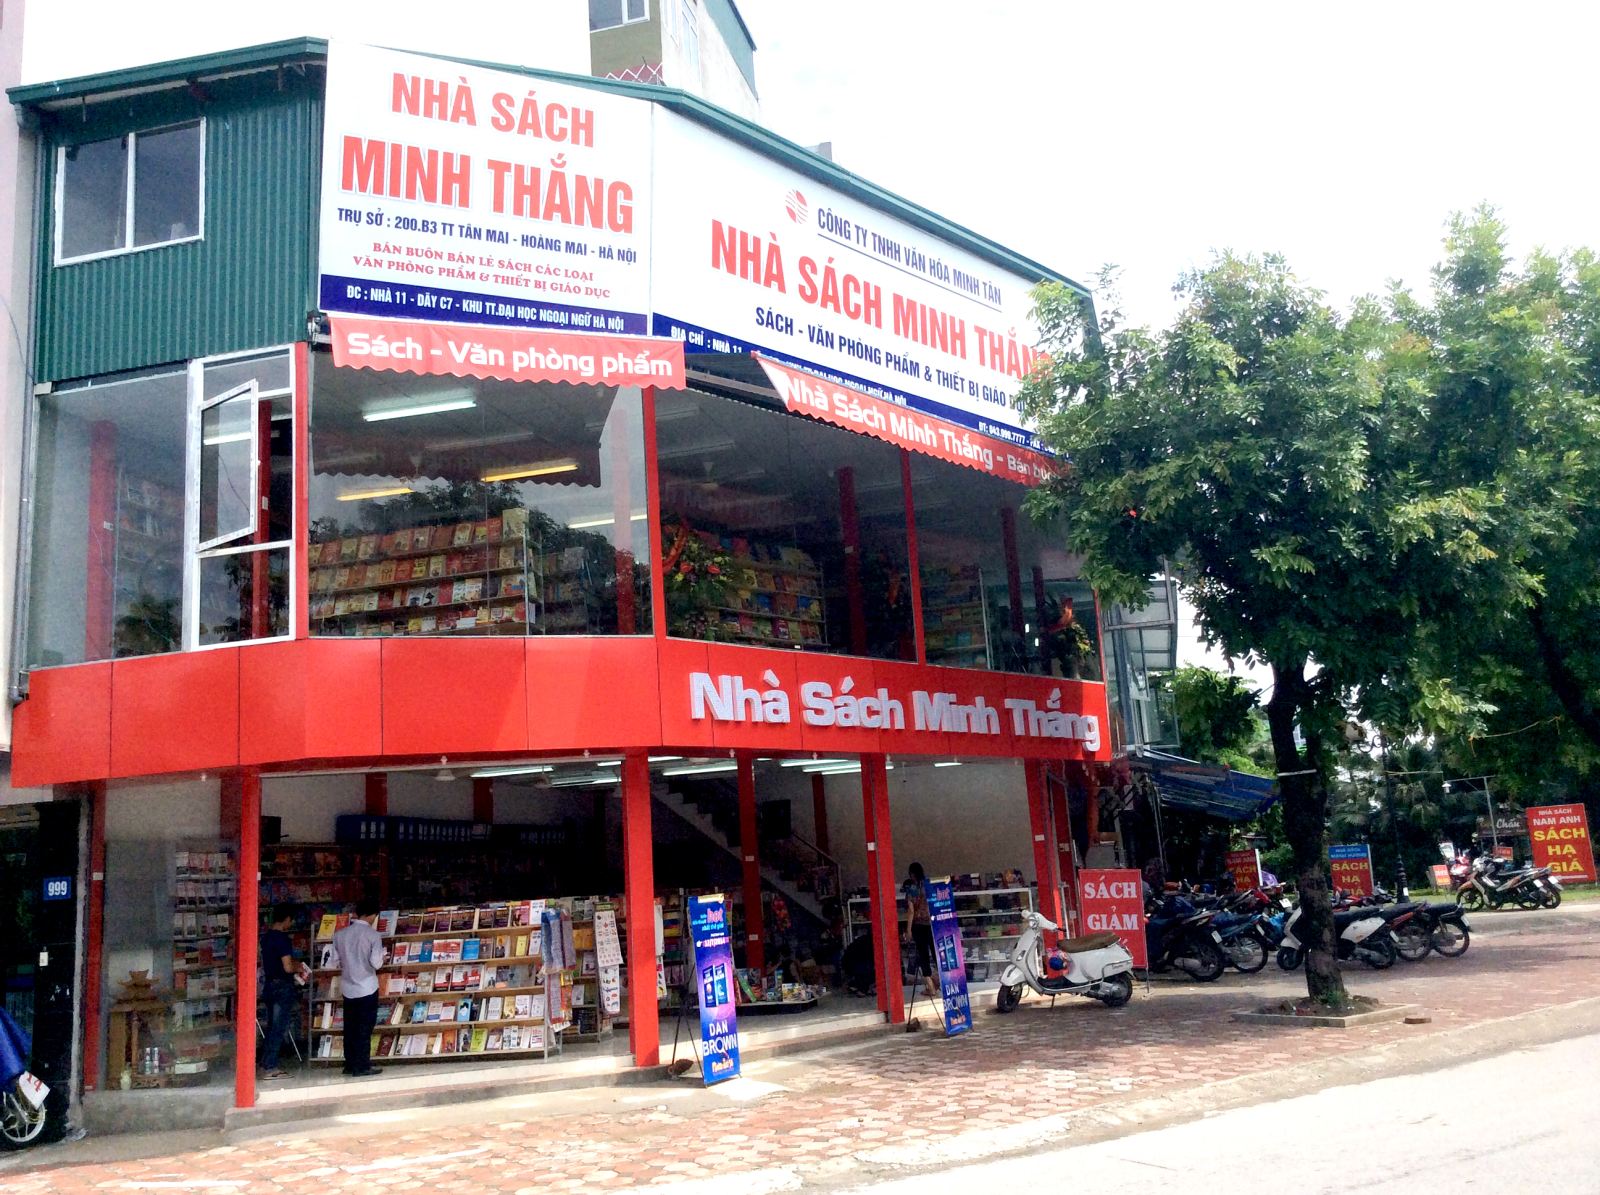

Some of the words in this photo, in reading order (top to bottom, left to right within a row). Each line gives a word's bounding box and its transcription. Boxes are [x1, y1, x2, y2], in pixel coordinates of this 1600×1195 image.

[392, 72, 477, 127] NHÀ
[491, 89, 594, 148] SÁCH
[341, 134, 471, 209] MINH
[486, 152, 634, 234] THẮNG
[337, 208, 361, 226] TRỤ
[366, 207, 384, 226] SỞ
[395, 215, 437, 234] 200.B3
[441, 222, 454, 236] TT
[458, 222, 482, 241] TÂN
[486, 228, 509, 244] MAI
[521, 233, 561, 252] HOÀNG
[565, 240, 587, 256] MAI
[599, 244, 613, 260] HÀ
[617, 247, 637, 266] NỘI
[373, 241, 402, 254] BÁN
[405, 246, 443, 261] BUÔN
[447, 251, 475, 265] BÁN
[479, 254, 494, 268] LẺ
[497, 258, 532, 272] SÁCH
[535, 264, 561, 277] CÁC
[564, 269, 594, 283] LOẠI
[817, 207, 851, 240] CÔNG
[854, 224, 868, 248] TY
[871, 232, 901, 262] TNHH
[904, 246, 927, 273] VĂN
[929, 258, 950, 284] HÓA
[953, 268, 980, 297] MINH
[982, 280, 1002, 306] TÂN
[353, 255, 383, 268] VĂN
[387, 260, 434, 275] PHÒNG
[438, 265, 476, 281] PHẨM
[479, 272, 490, 282] &
[493, 273, 531, 288] THIẾT
[534, 279, 547, 292] BỊ
[550, 281, 582, 295] GIÁO
[585, 286, 611, 299] DỤC
[346, 285, 361, 299] ĐC
[370, 286, 392, 304] NHÀ
[395, 291, 407, 305] 11
[440, 296, 453, 310] C7
[462, 299, 483, 314] KHU
[485, 301, 515, 320] TT.ĐẠI
[517, 305, 537, 323] HỌC
[539, 308, 569, 327] NGOẠI
[571, 311, 591, 327] NGỮ
[593, 313, 606, 329] HÀ
[607, 316, 624, 333] NỘI
[711, 218, 787, 294] NHÀ
[798, 256, 883, 329] SÁCH
[893, 292, 967, 360] MINH
[974, 326, 1055, 384] THẮN
[688, 330, 704, 346] CHỈ
[712, 338, 731, 353] NHÀ
[732, 345, 742, 353] 11
[347, 332, 423, 361] Sách
[448, 339, 505, 368] Văn
[512, 346, 595, 377] phòng
[602, 350, 673, 378] phẩm
[755, 306, 794, 336] SÁCH
[807, 323, 835, 350] VĂN
[838, 335, 882, 366] PHÒNG
[885, 351, 920, 379] PHẨM
[924, 365, 933, 383] &
[935, 369, 965, 394] THIẾT
[968, 380, 979, 402] BỊ
[982, 385, 1006, 408] GIÁO
[783, 371, 829, 411] Nhà
[832, 392, 886, 432] Sách
[889, 411, 938, 448] Minh
[938, 432, 994, 471] Thắng
[1007, 453, 1030, 476] Bán
[689, 668, 791, 724] Nhà
[801, 675, 905, 730] Sách
[911, 690, 1001, 735] Minh
[1004, 687, 1102, 752] Thắng
[1533, 817, 1556, 826] NAM
[1559, 815, 1581, 825] ANH
[1533, 826, 1586, 841] SÁCH
[1547, 844, 1577, 858] HẠ
[1332, 861, 1369, 871] SÁCH
[1547, 858, 1584, 873] GIÁ
[48, 880, 68, 897] 999
[1084, 875, 1138, 899] SÁCH
[1342, 875, 1360, 885] HẠ
[1087, 905, 1140, 931] GIẢM
[945, 982, 960, 996] DAN
[708, 1020, 728, 1037] DAN
[702, 1033, 738, 1057] BROWN
